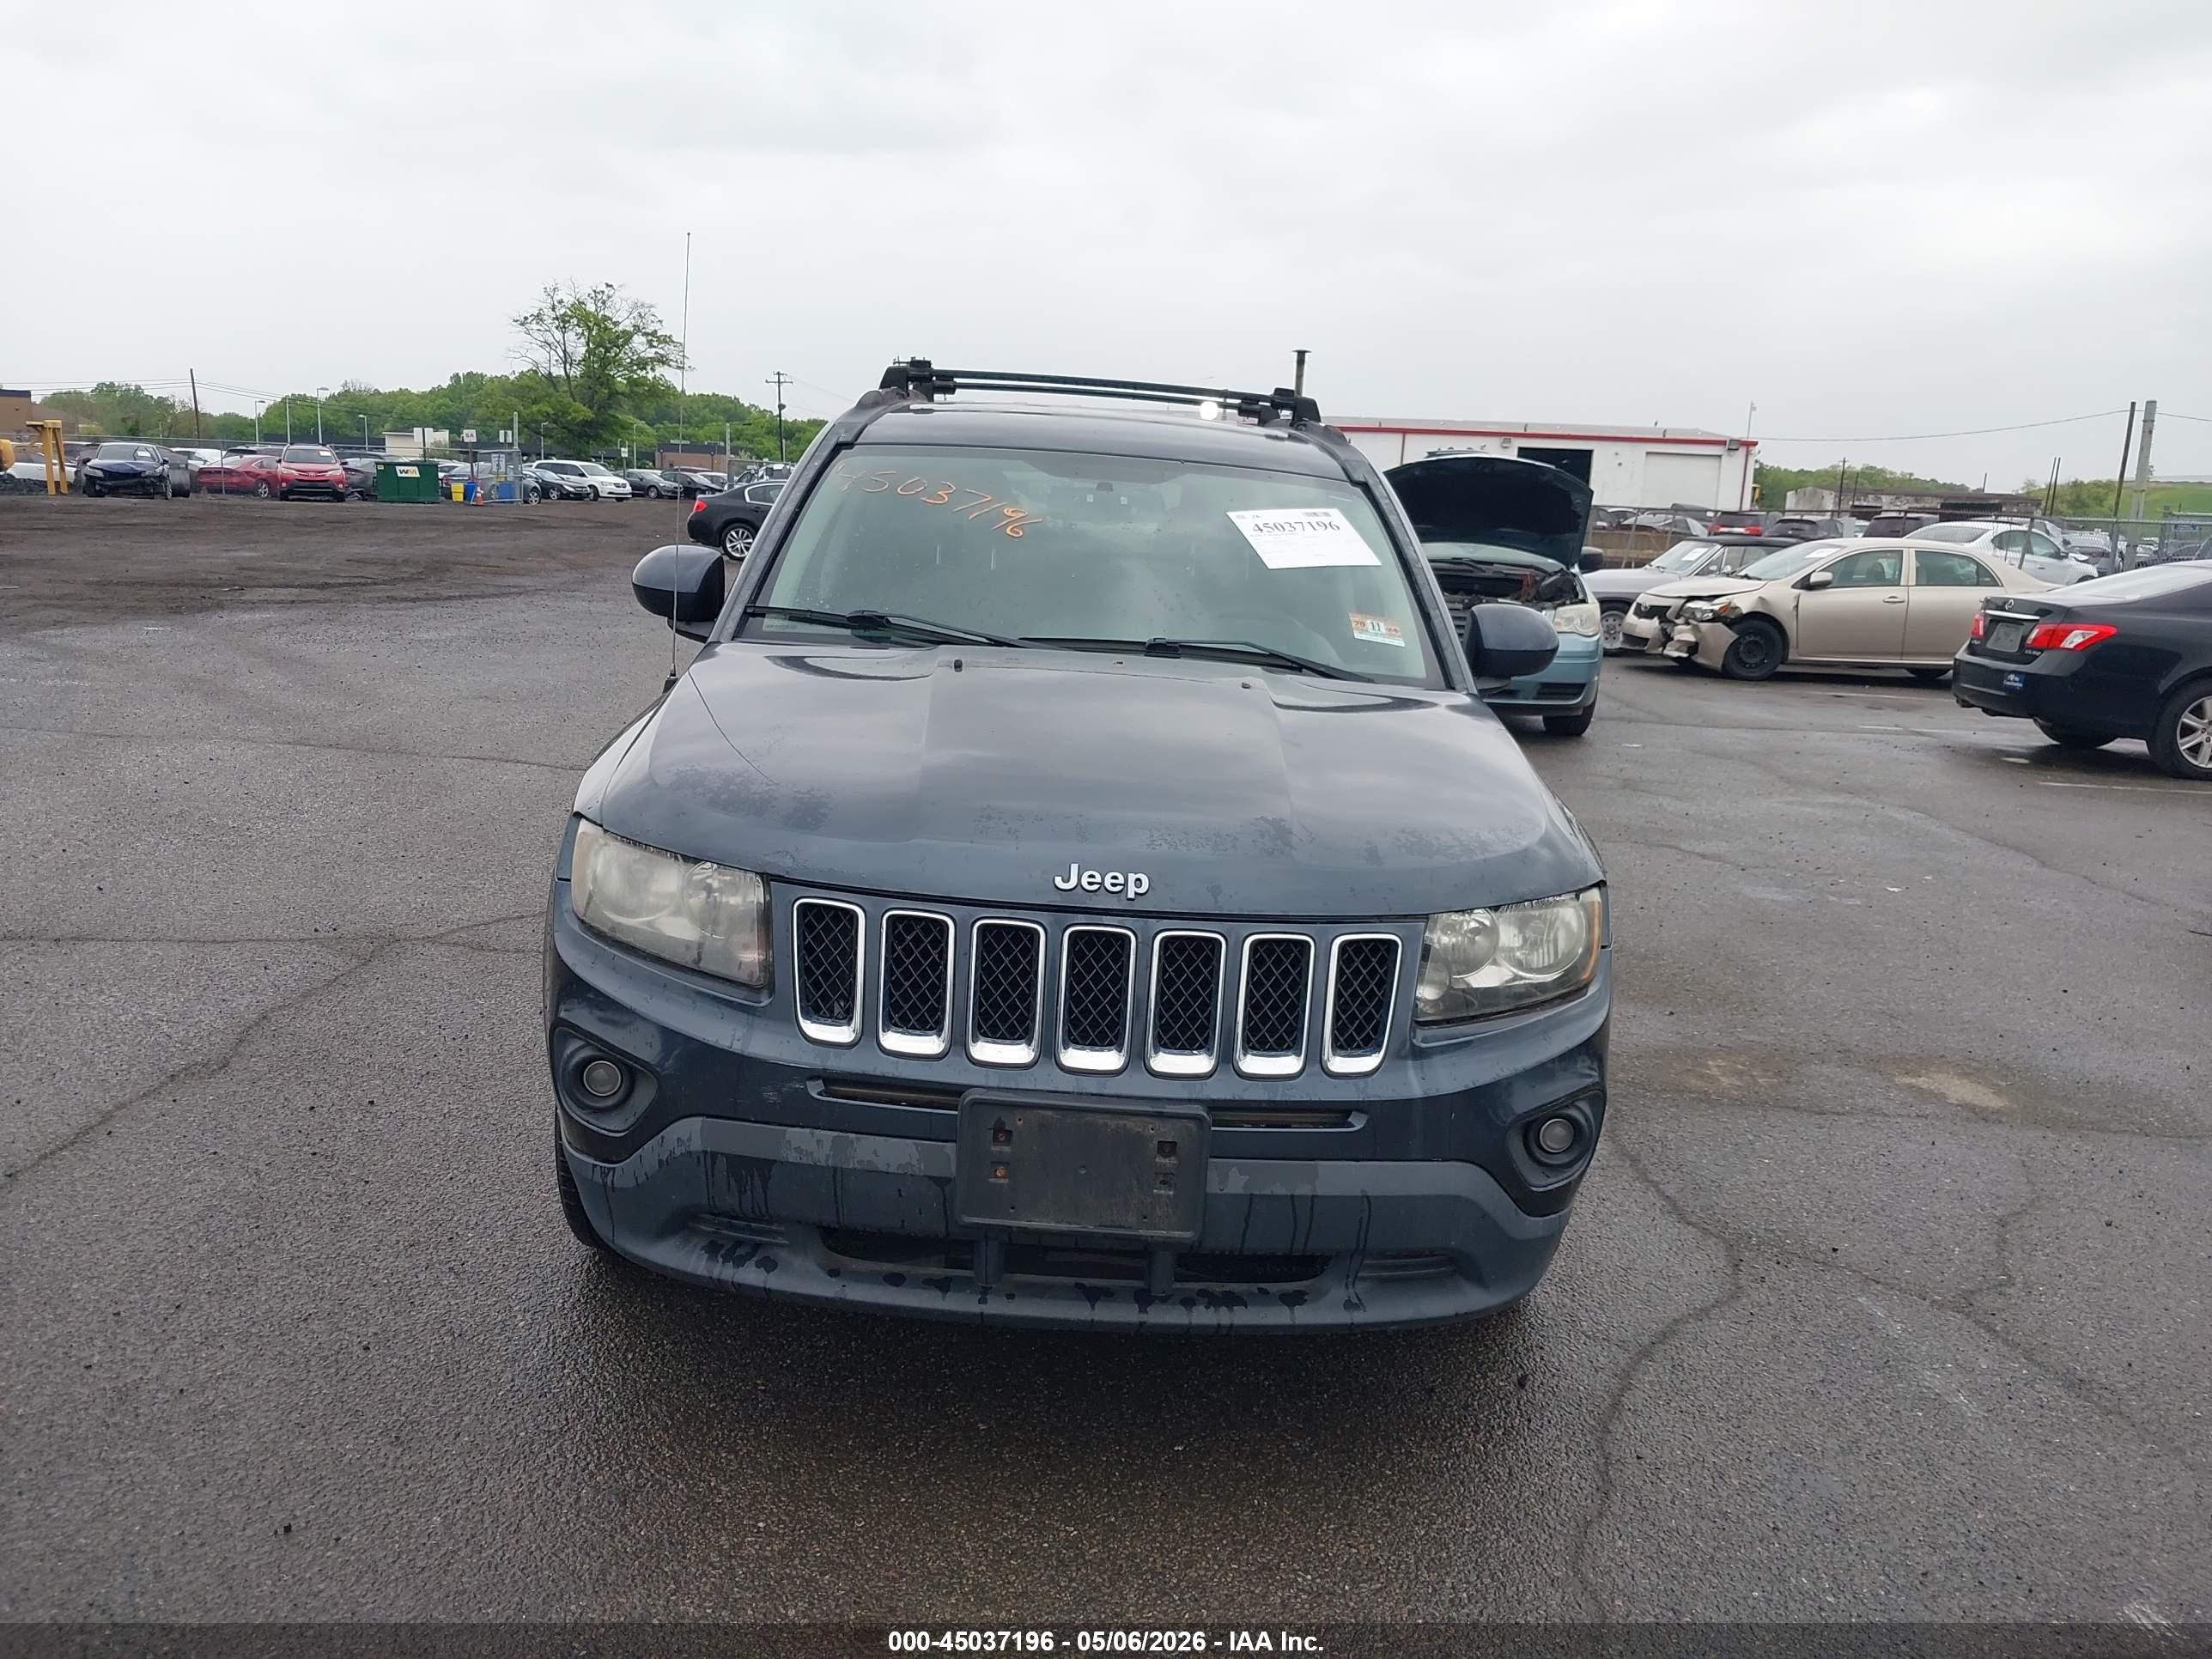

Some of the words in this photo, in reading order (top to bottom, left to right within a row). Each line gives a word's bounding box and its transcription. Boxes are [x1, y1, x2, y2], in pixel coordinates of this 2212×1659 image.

[837, 464, 1043, 538] 45037196
[1252, 520, 1340, 534] 45037196
[1054, 862, 1151, 901] Jeep
